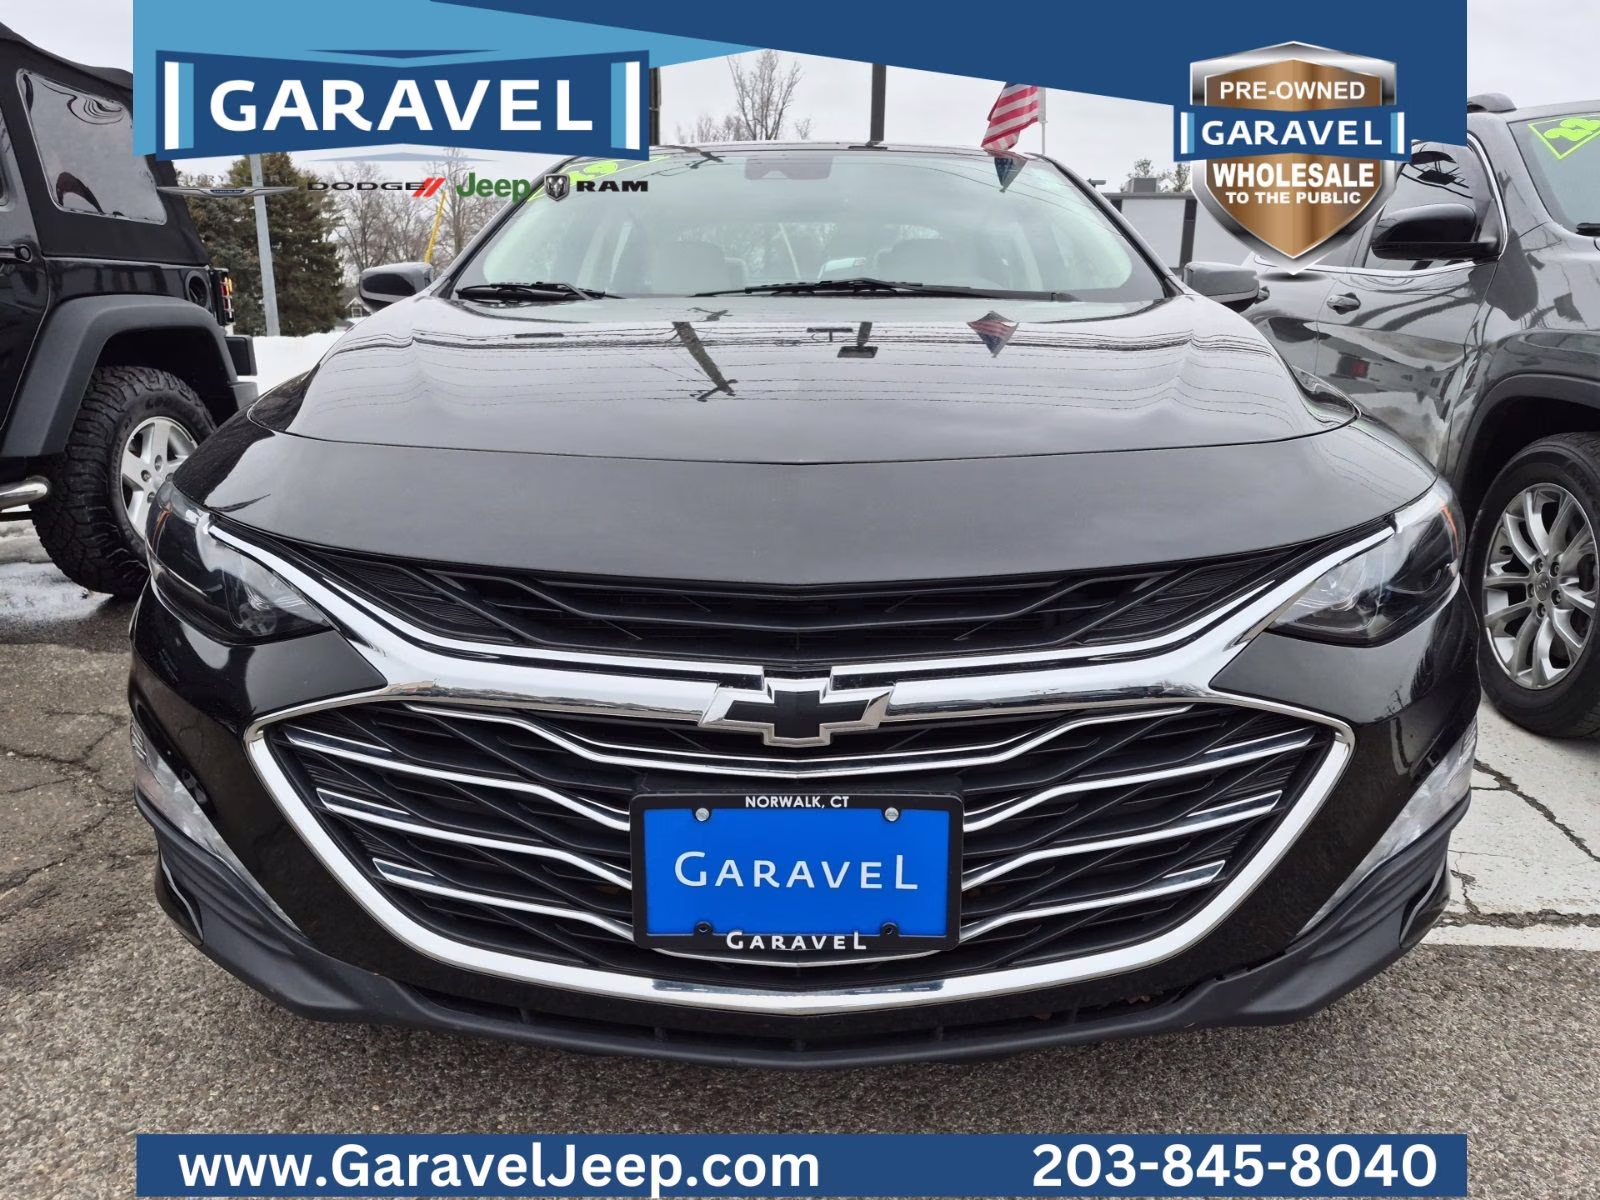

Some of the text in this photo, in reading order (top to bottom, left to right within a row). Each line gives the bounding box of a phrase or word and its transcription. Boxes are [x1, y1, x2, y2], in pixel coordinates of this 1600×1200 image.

[745, 795, 849, 809] NORWALK, CT
[674, 851, 918, 890] GARAVEL
[726, 930, 867, 951] GARAVEL
